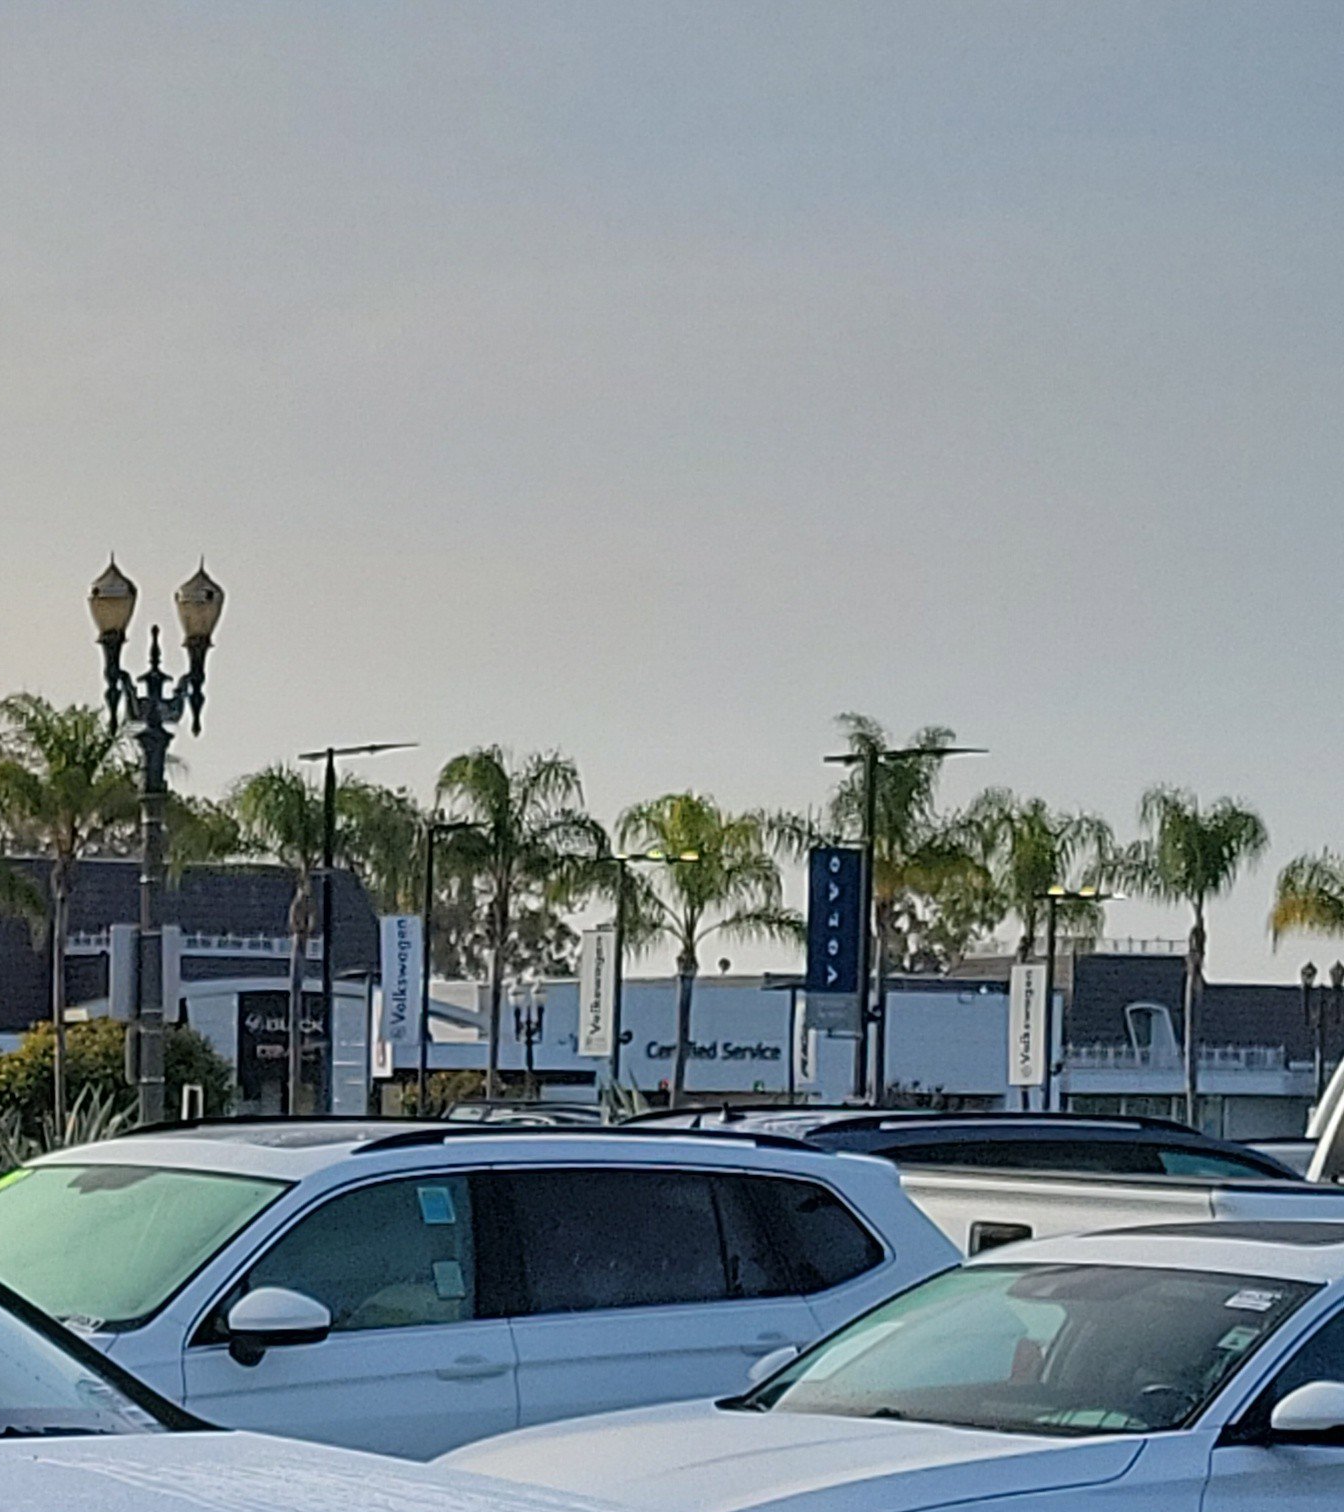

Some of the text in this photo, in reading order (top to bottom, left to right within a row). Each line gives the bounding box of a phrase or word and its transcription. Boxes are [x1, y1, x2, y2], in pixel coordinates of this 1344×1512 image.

[826, 855, 840, 985] VOLVO
[390, 919, 411, 1025] Volkswagen
[265, 1017, 324, 1034] BUCK
[721, 1042, 782, 1060] Service
